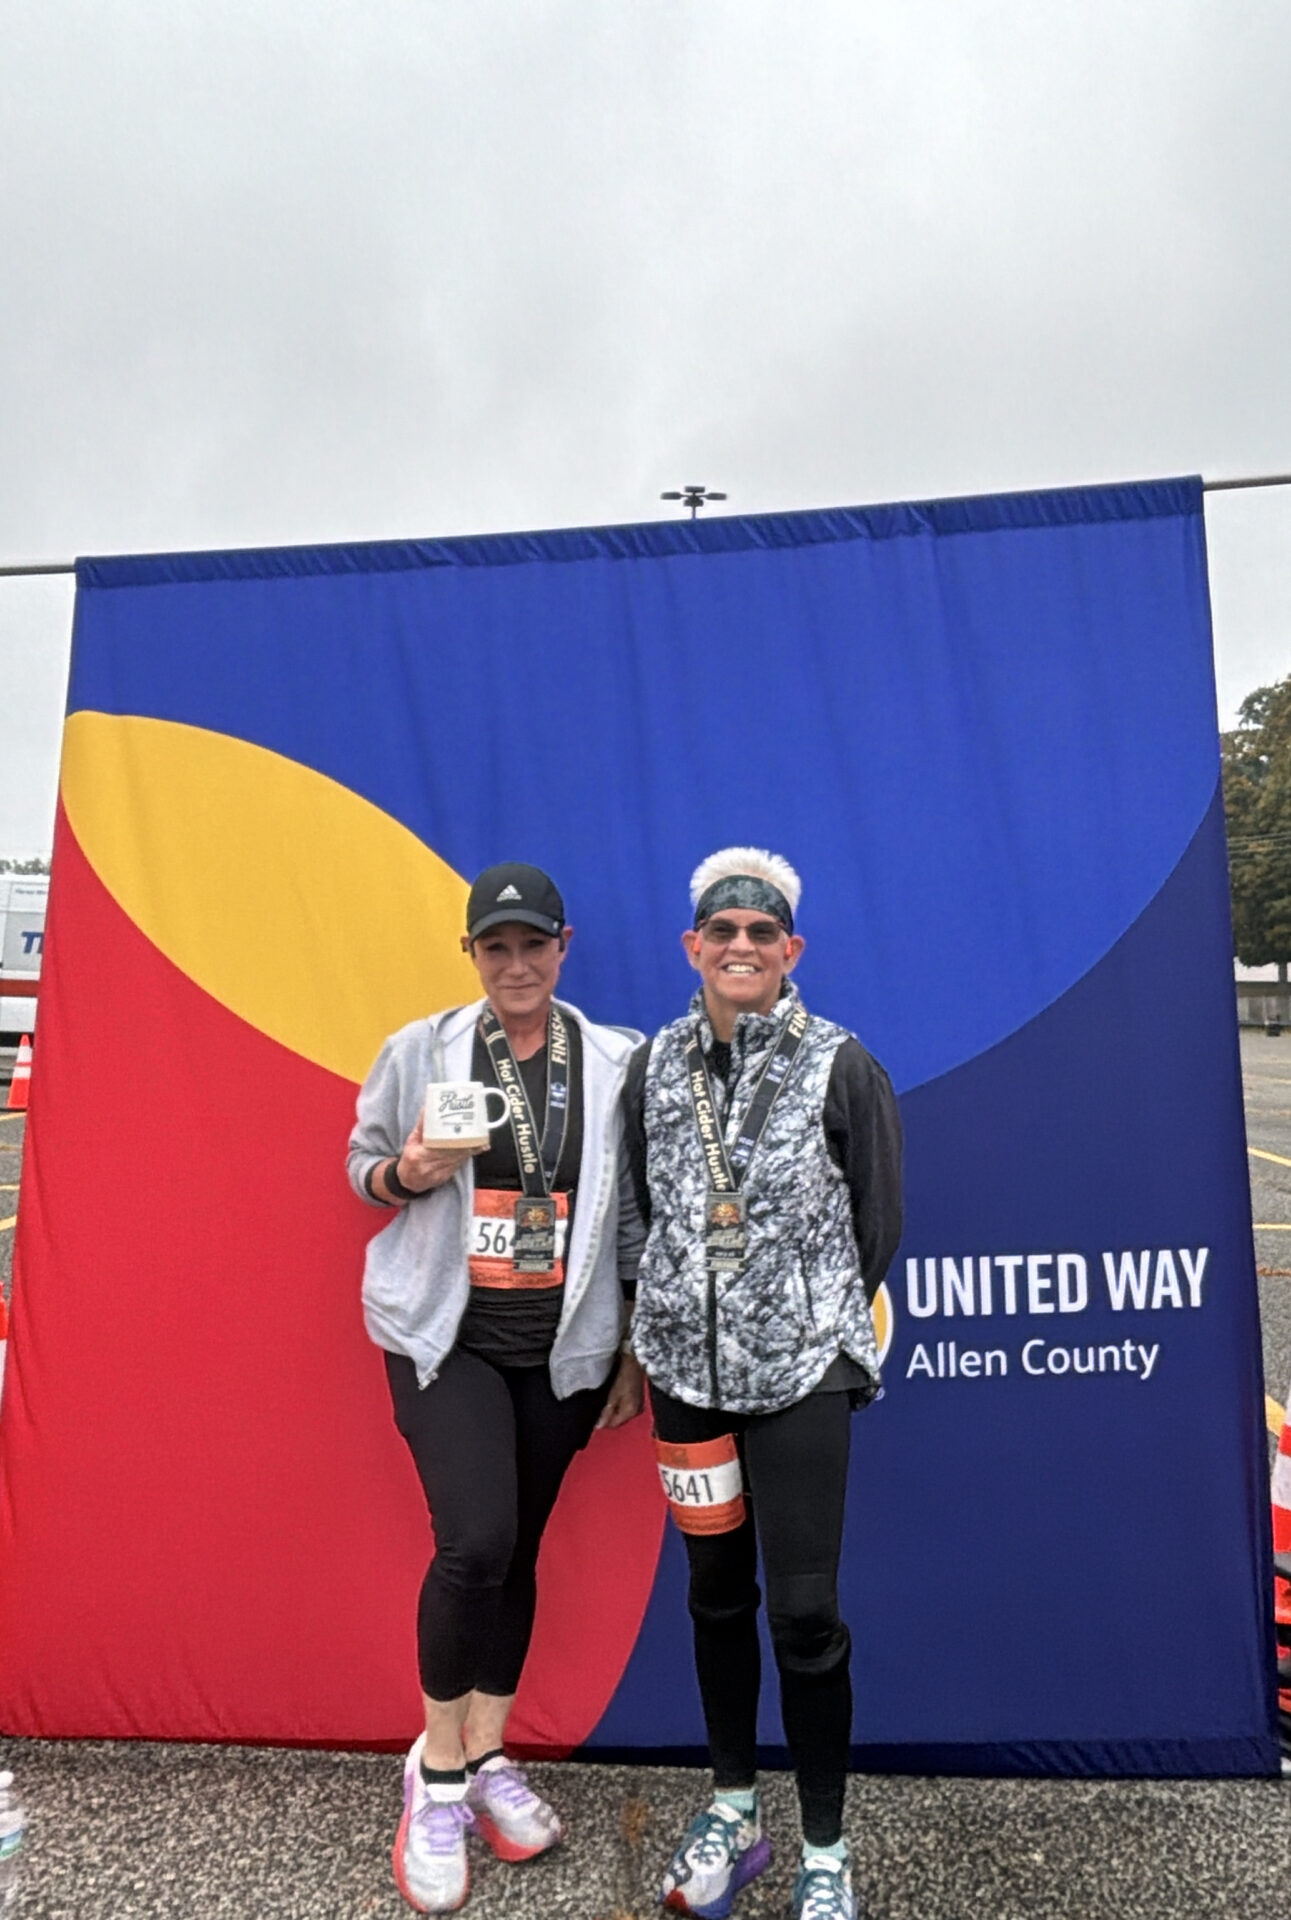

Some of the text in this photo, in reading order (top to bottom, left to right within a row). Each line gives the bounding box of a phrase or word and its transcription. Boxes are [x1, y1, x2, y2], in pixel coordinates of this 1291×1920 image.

[496, 1058, 538, 1174] Hot Cider Hustle
[691, 1070, 729, 1191] Hot Cider Hustle
[476, 1222, 516, 1255] 56
[905, 1248, 1209, 1318] UNITED WAY
[906, 1339, 1160, 1381] Allen County
